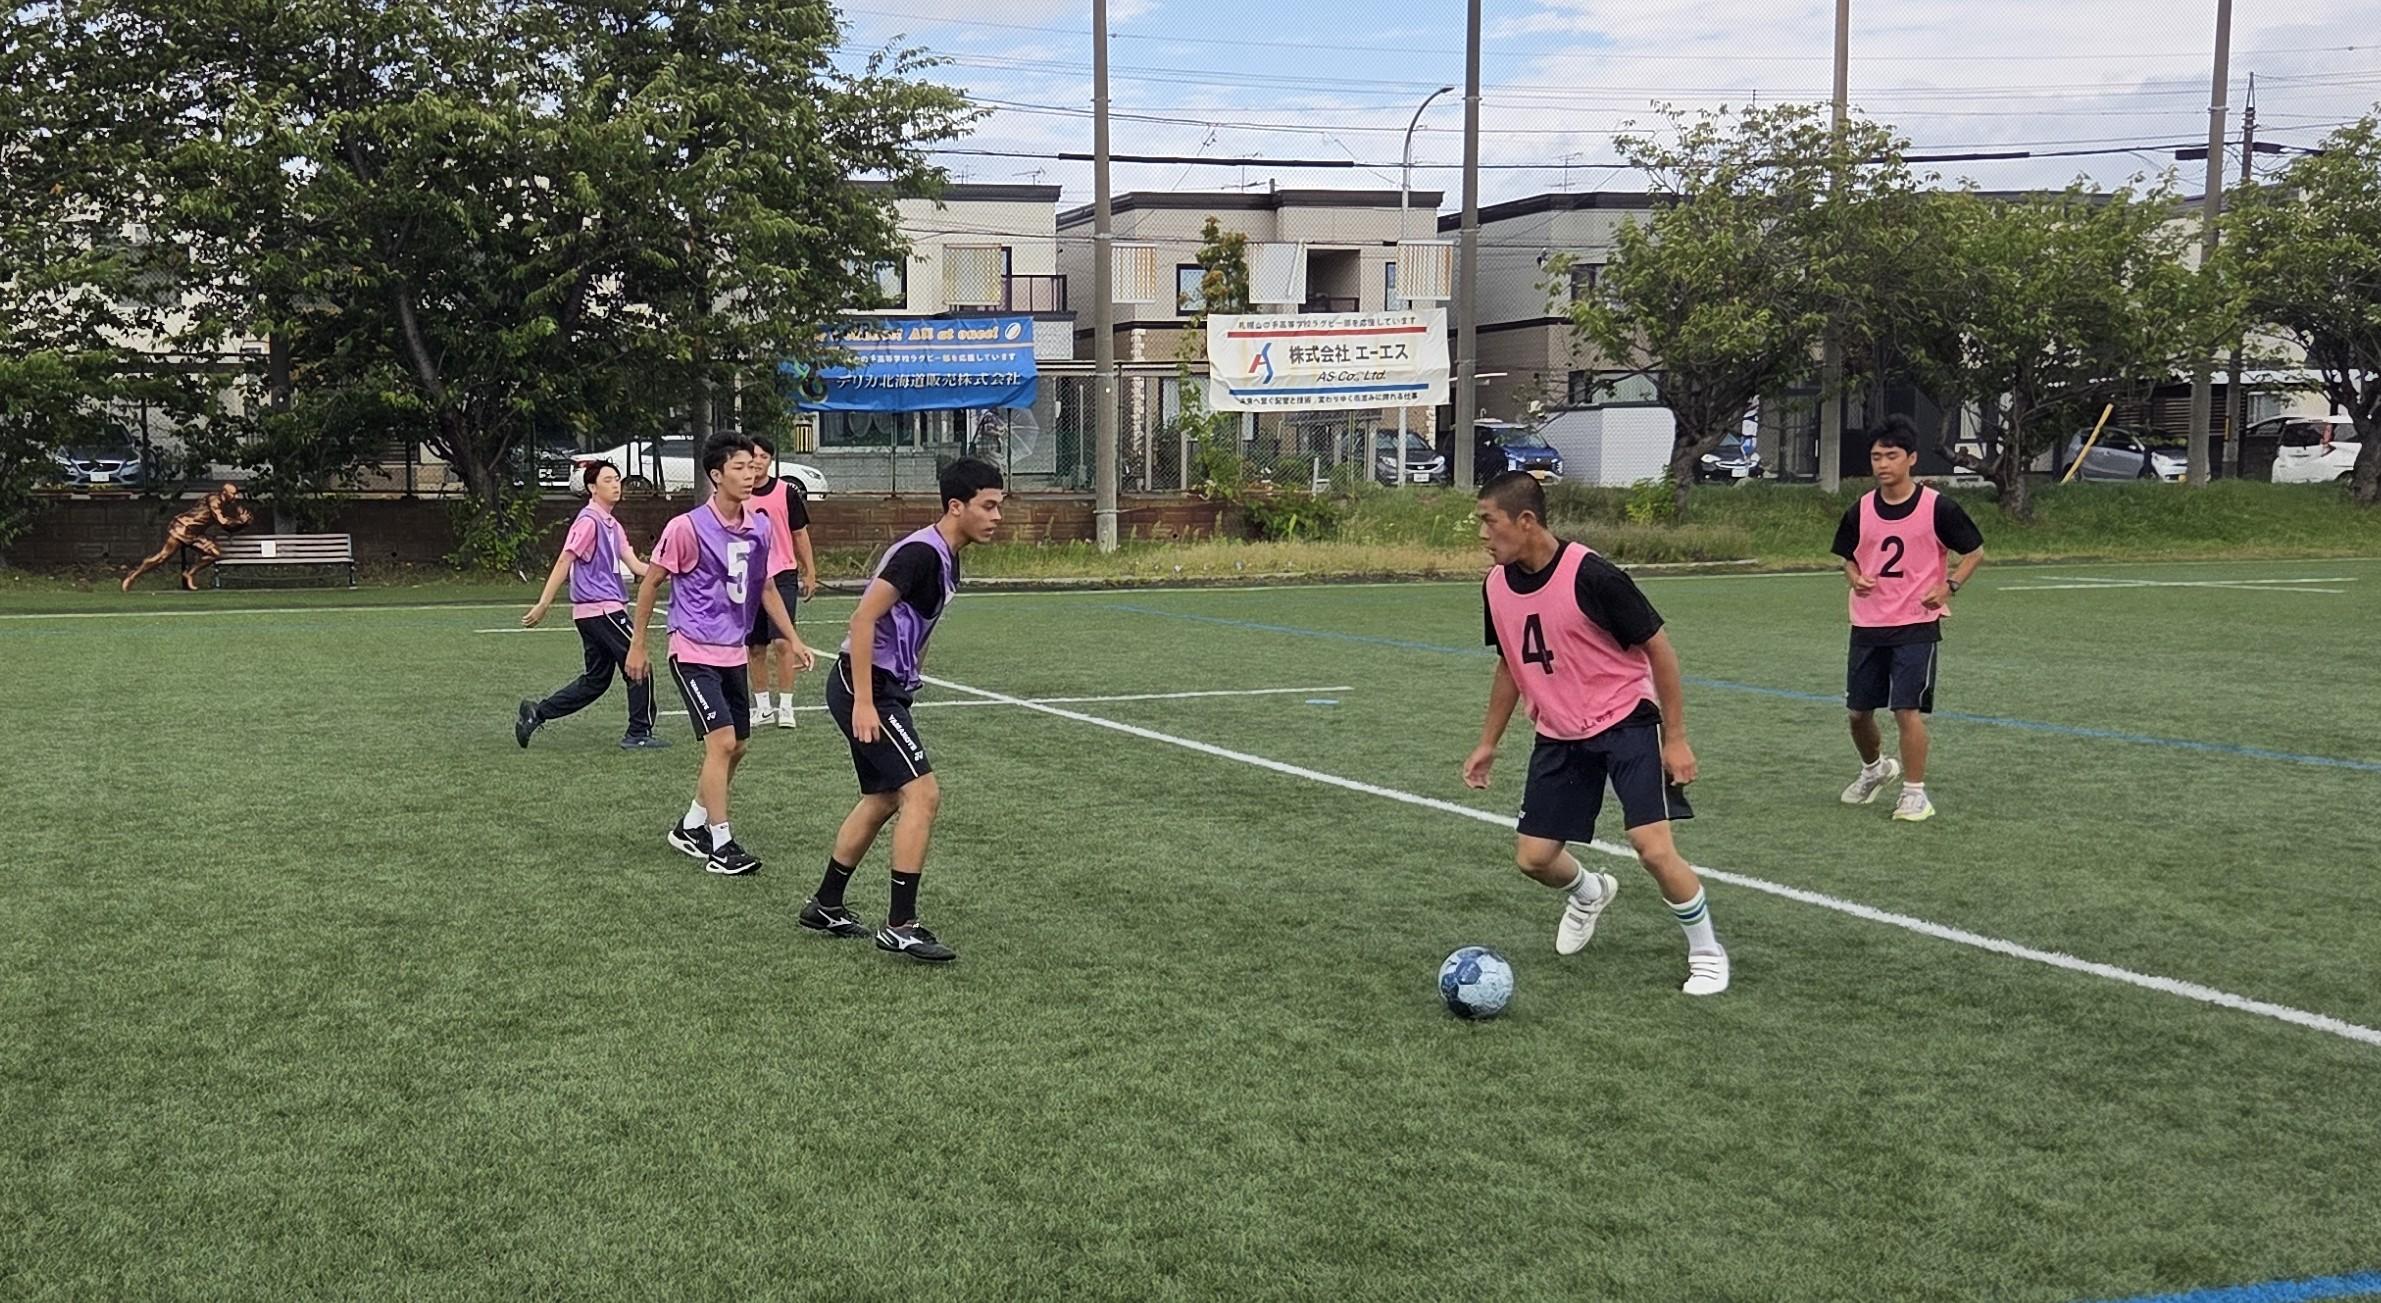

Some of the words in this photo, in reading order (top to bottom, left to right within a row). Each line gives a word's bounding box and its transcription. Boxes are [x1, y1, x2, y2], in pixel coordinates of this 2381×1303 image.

[1289, 344, 1350, 364] 株式会社
[1356, 344, 1408, 360] エーエス
[836, 371, 1021, 389] デリカ北海道販売株式会社
[1316, 371, 1335, 382] AS
[1363, 369, 1386, 381] Ltd.
[1879, 535, 1905, 578] 2
[727, 541, 751, 604] 5
[1521, 613, 1554, 675] 4
